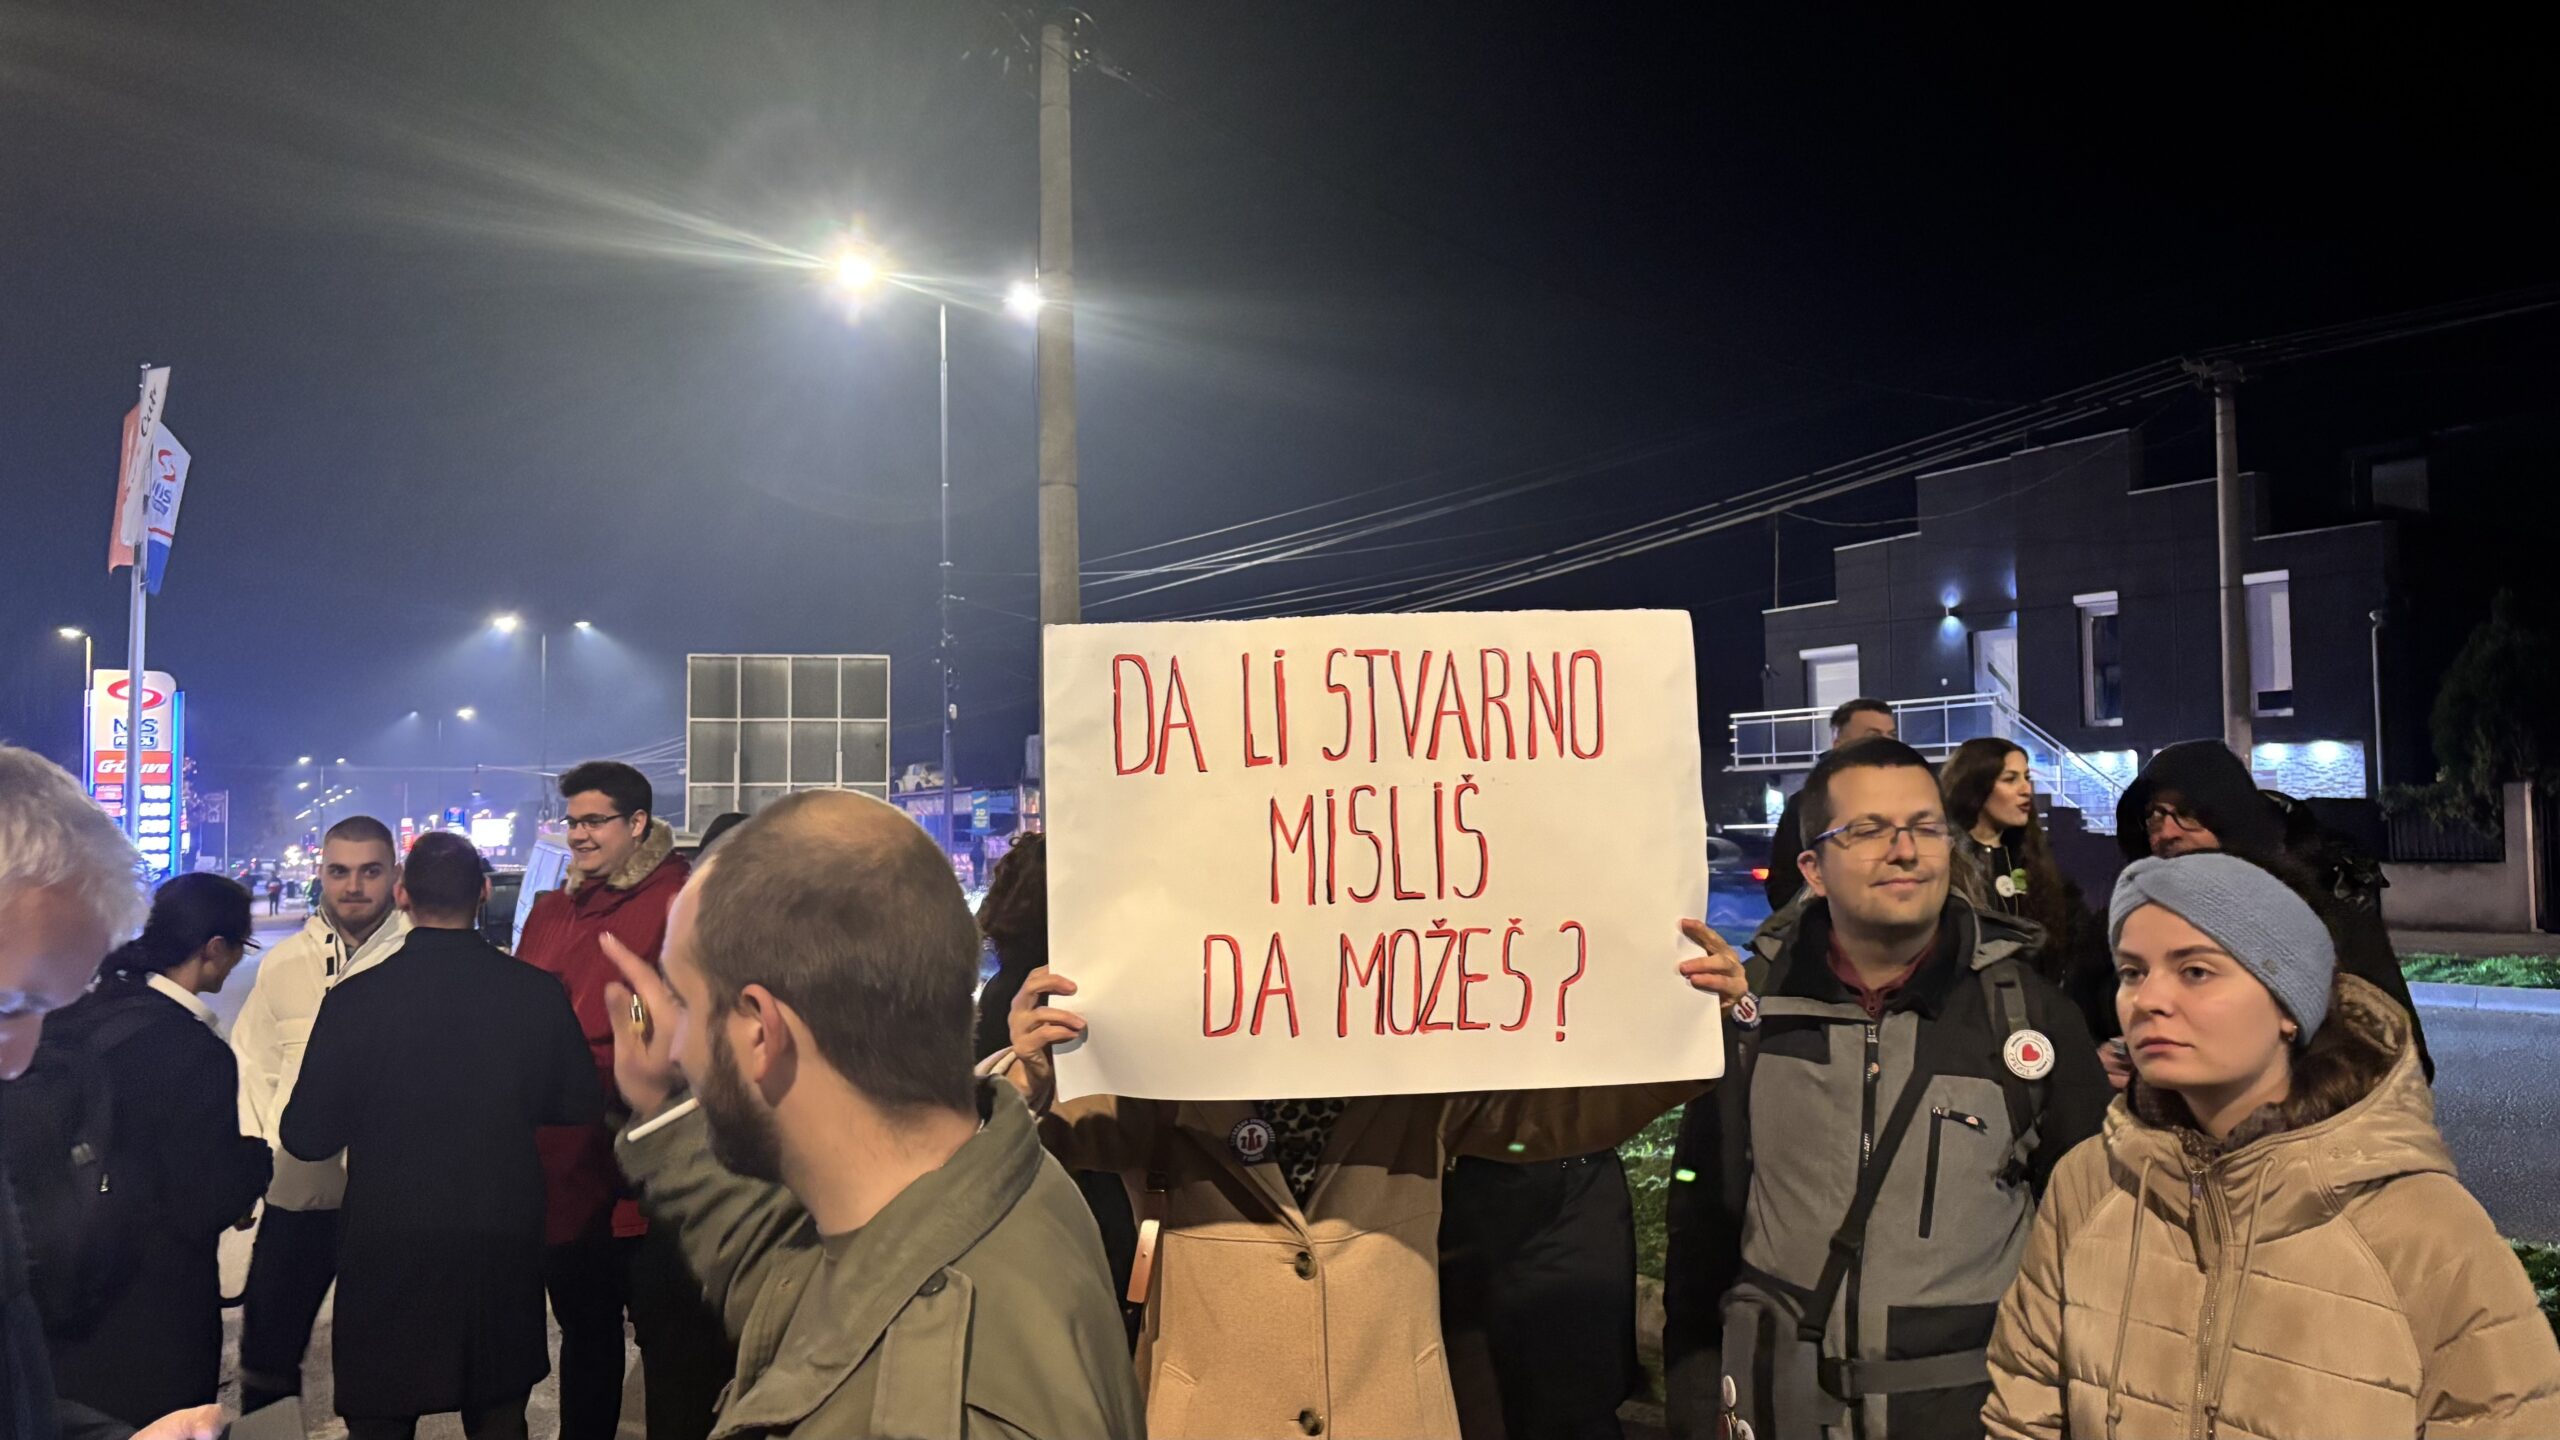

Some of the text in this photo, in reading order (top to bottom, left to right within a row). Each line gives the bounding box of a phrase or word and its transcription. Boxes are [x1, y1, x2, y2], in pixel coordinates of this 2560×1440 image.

[113, 718, 158, 735] NS
[1113, 653, 1208, 776] DA
[1321, 647, 1604, 762] STVARNO
[1203, 931, 1300, 1038] DA
